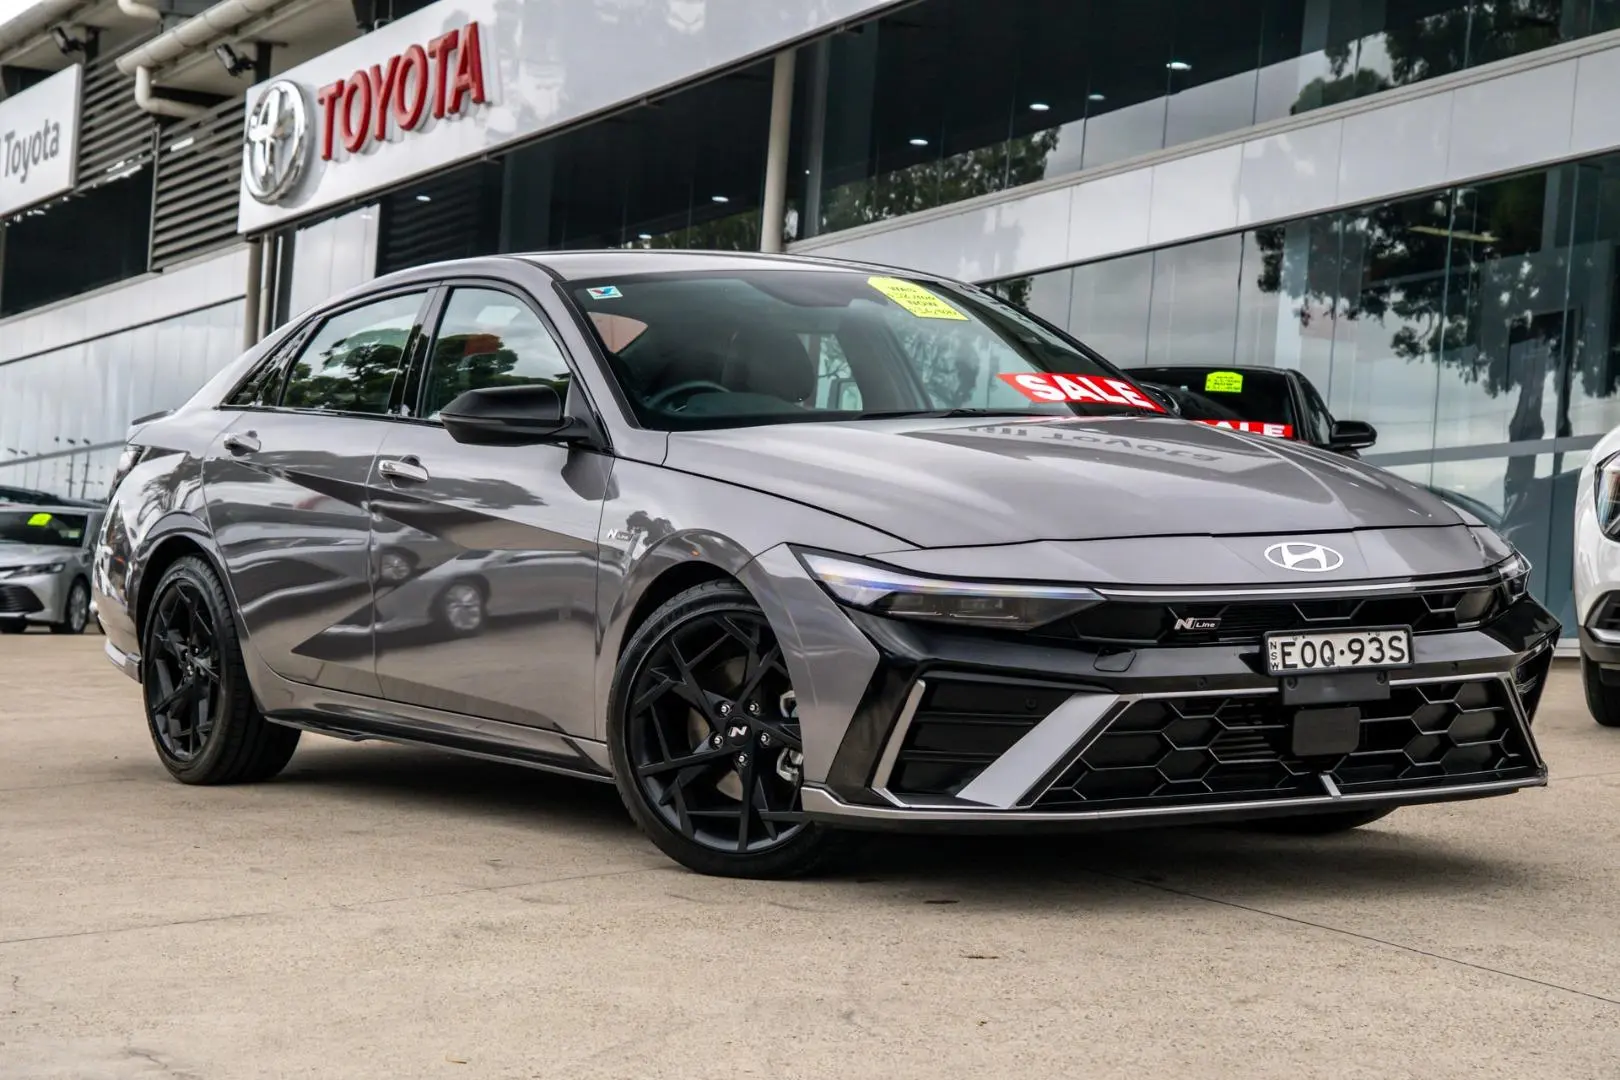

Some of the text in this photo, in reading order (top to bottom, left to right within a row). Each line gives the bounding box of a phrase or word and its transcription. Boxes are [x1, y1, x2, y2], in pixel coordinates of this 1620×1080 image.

[318, 21, 486, 161] TOYOTA
[4, 119, 61, 184] Toyota
[1015, 375, 1157, 409] SALE
